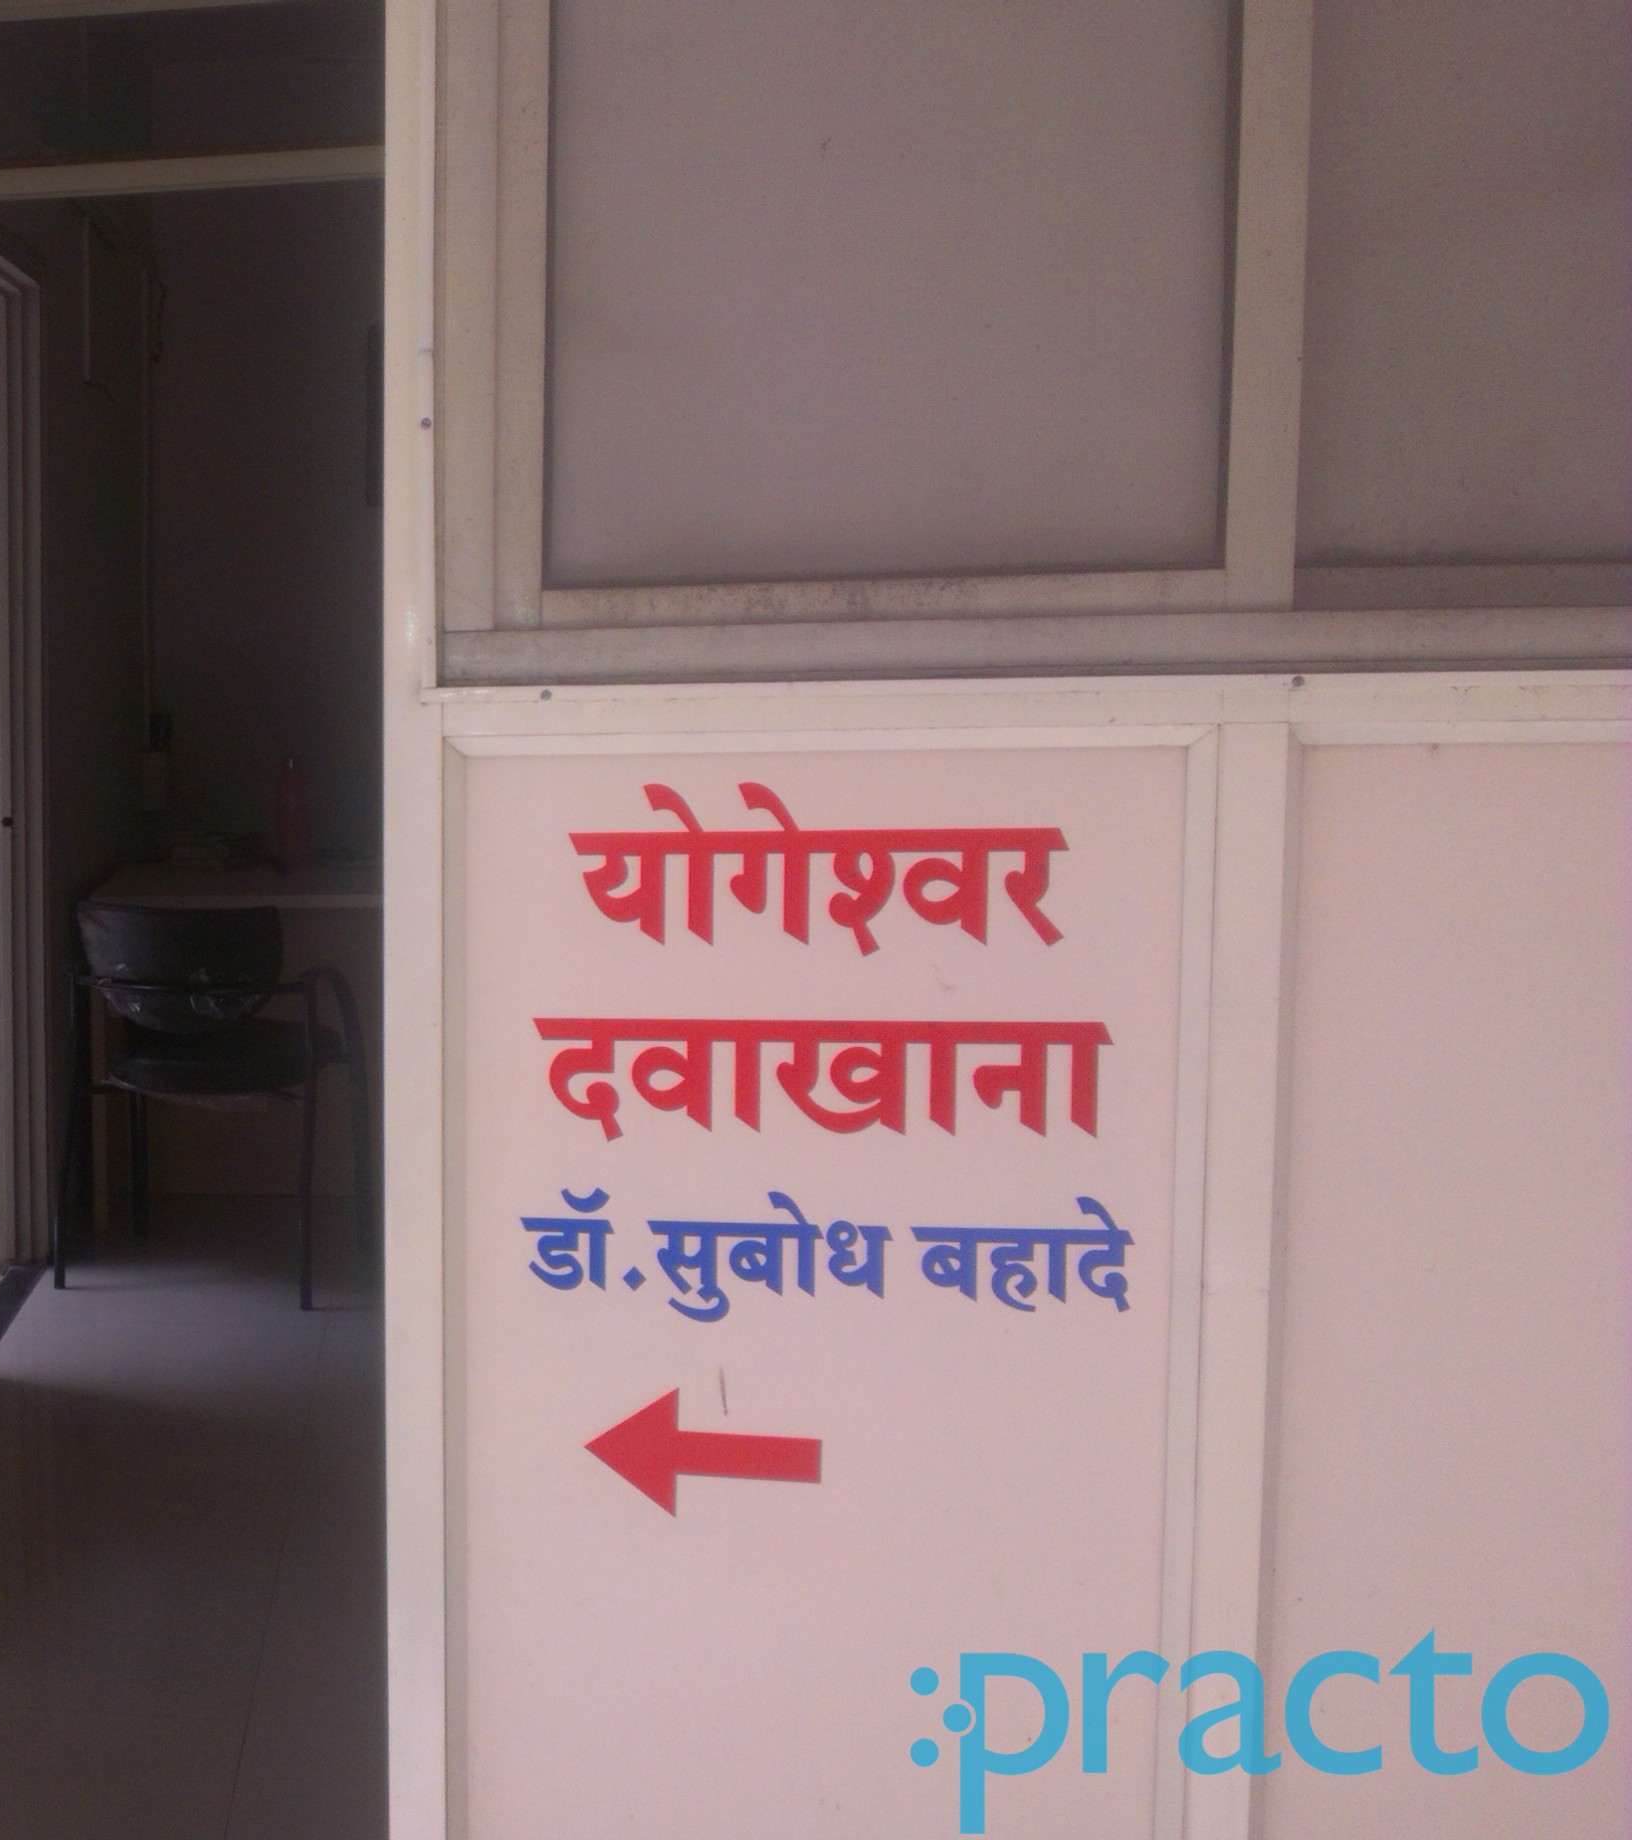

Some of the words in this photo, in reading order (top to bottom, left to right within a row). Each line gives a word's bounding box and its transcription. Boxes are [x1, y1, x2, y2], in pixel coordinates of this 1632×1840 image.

[568, 782, 1070, 956] योगेश्वर
[533, 1017, 1113, 1141] दवाखाना
[911, 1195, 1135, 1312] बहादे
